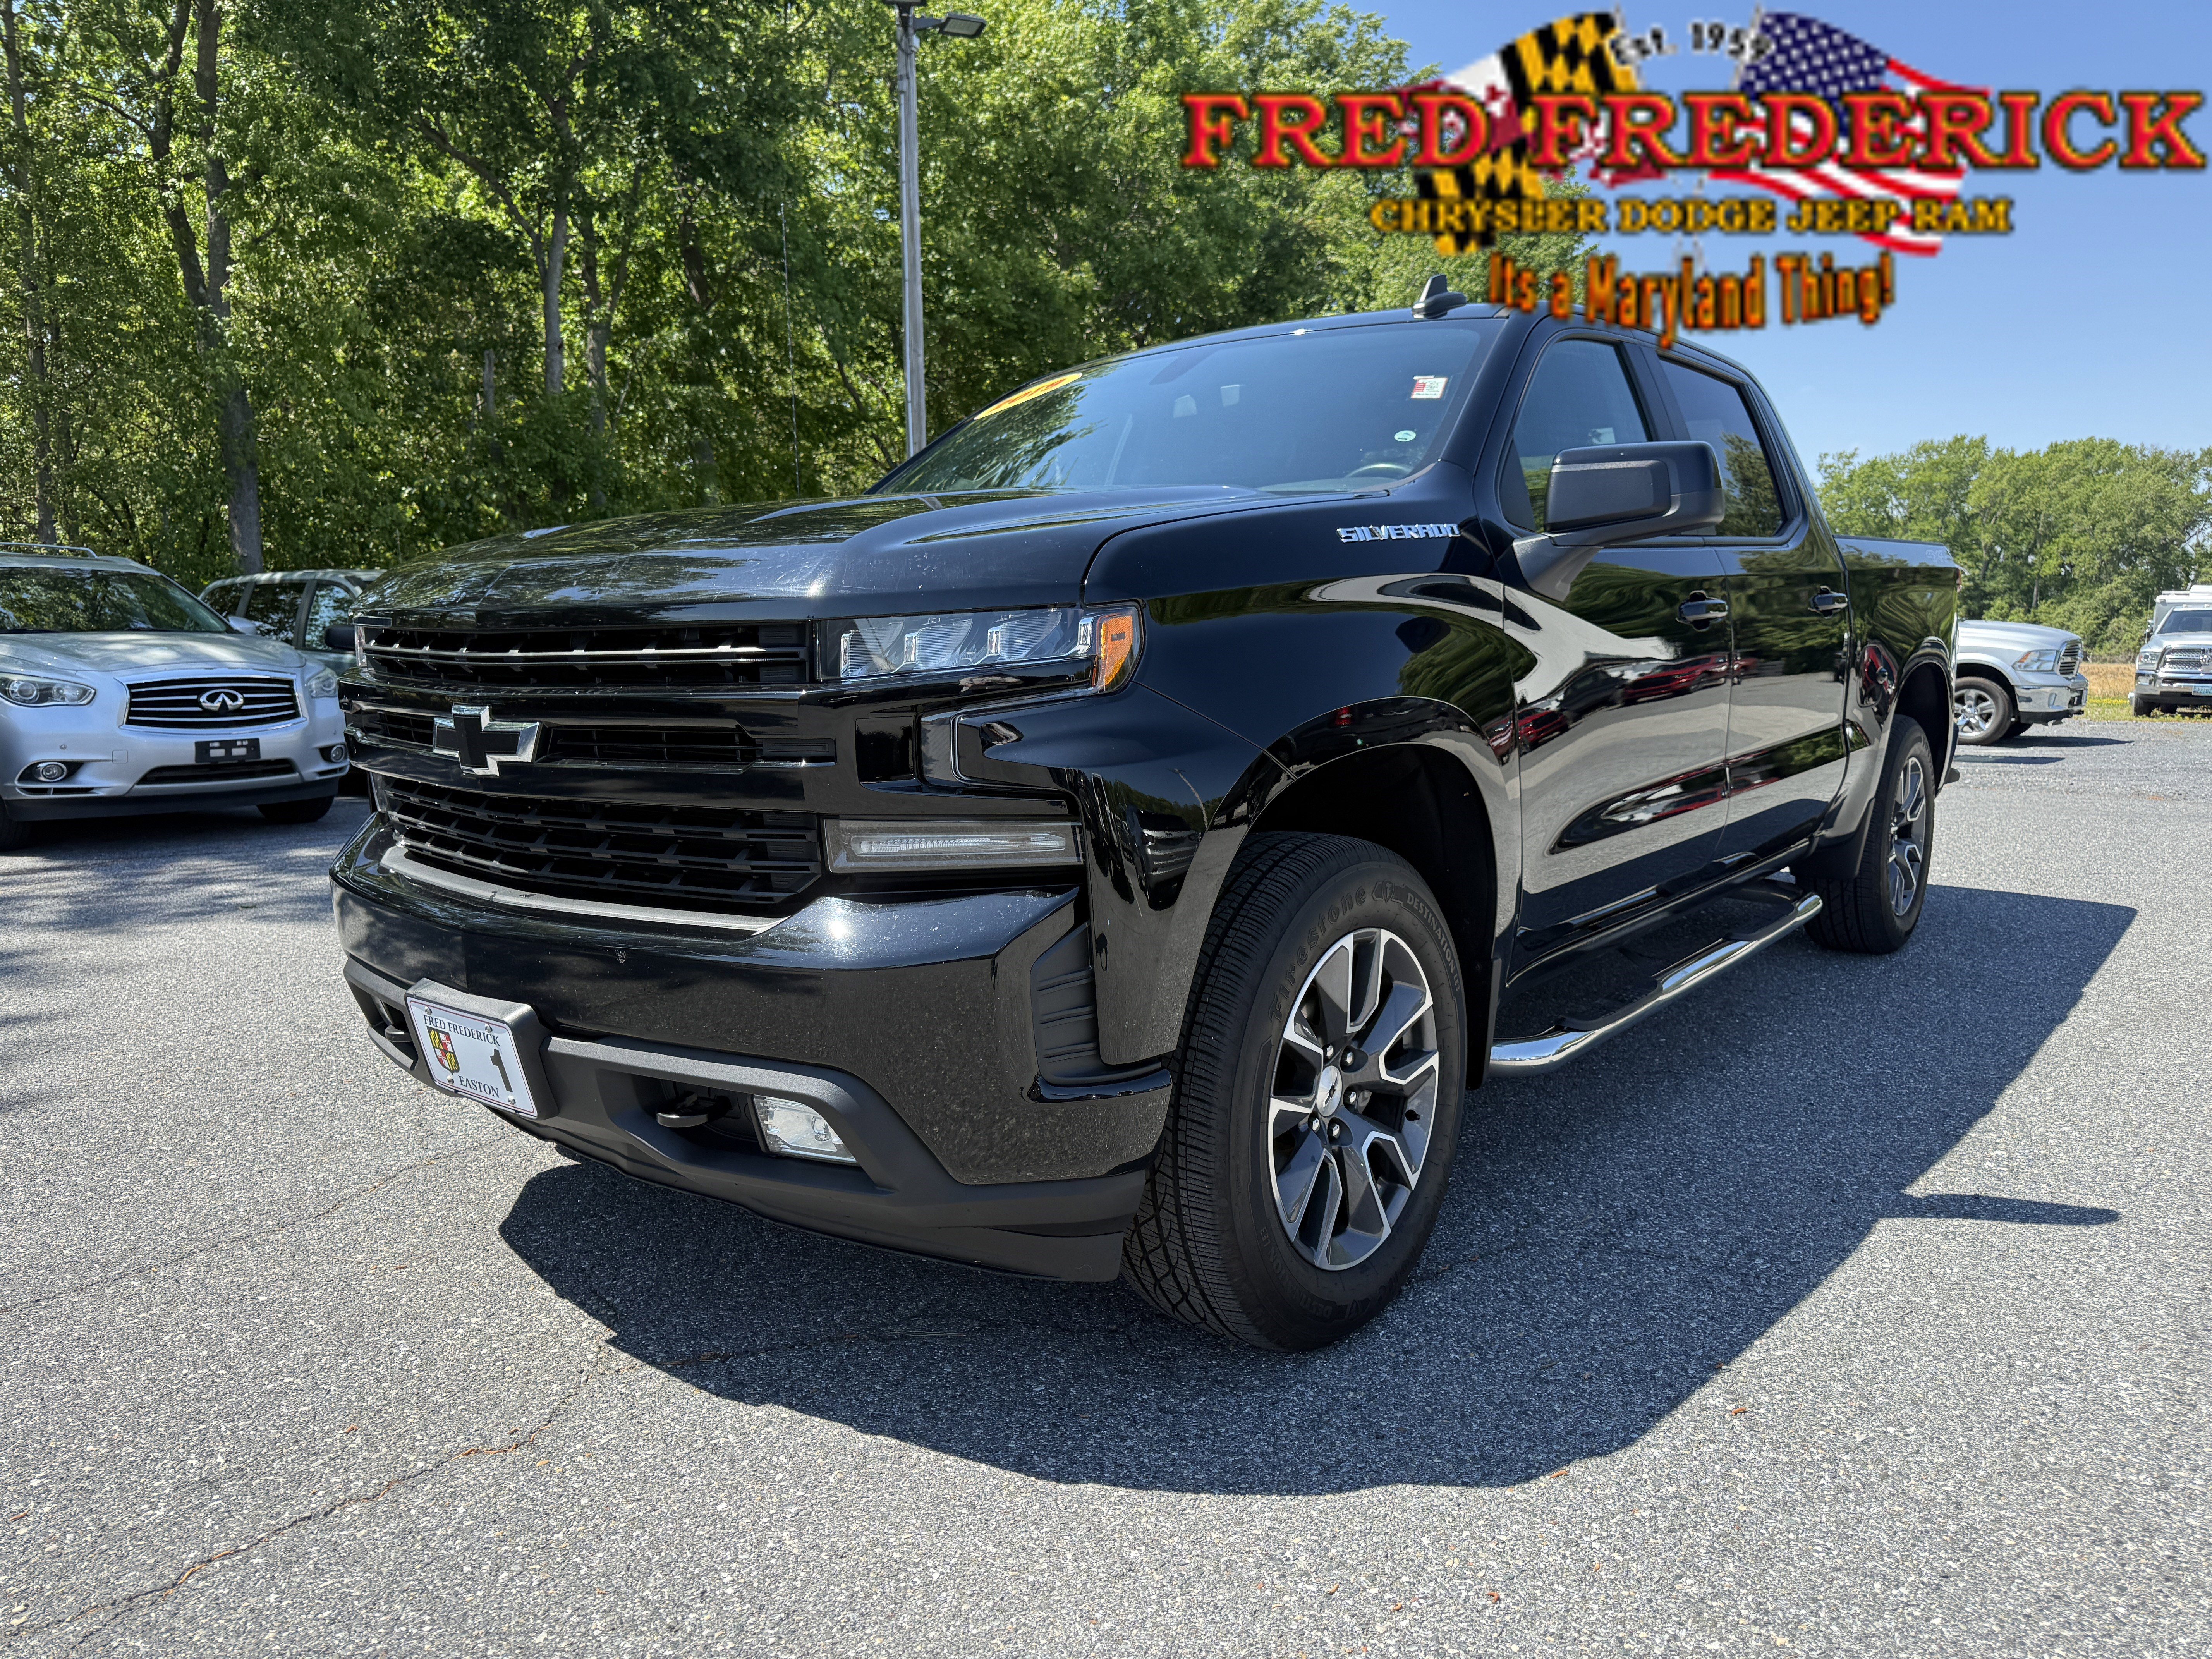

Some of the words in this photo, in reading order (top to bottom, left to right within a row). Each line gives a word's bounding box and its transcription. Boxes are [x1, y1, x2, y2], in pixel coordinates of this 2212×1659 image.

[1336, 523, 1462, 543] SILVERADO
[1407, 892, 1455, 973] DESTINATION
[422, 1014, 446, 1030] FRED
[447, 1021, 501, 1046] FREDERICK
[458, 1075, 500, 1098] EASTON
[489, 1049, 513, 1093] 1
